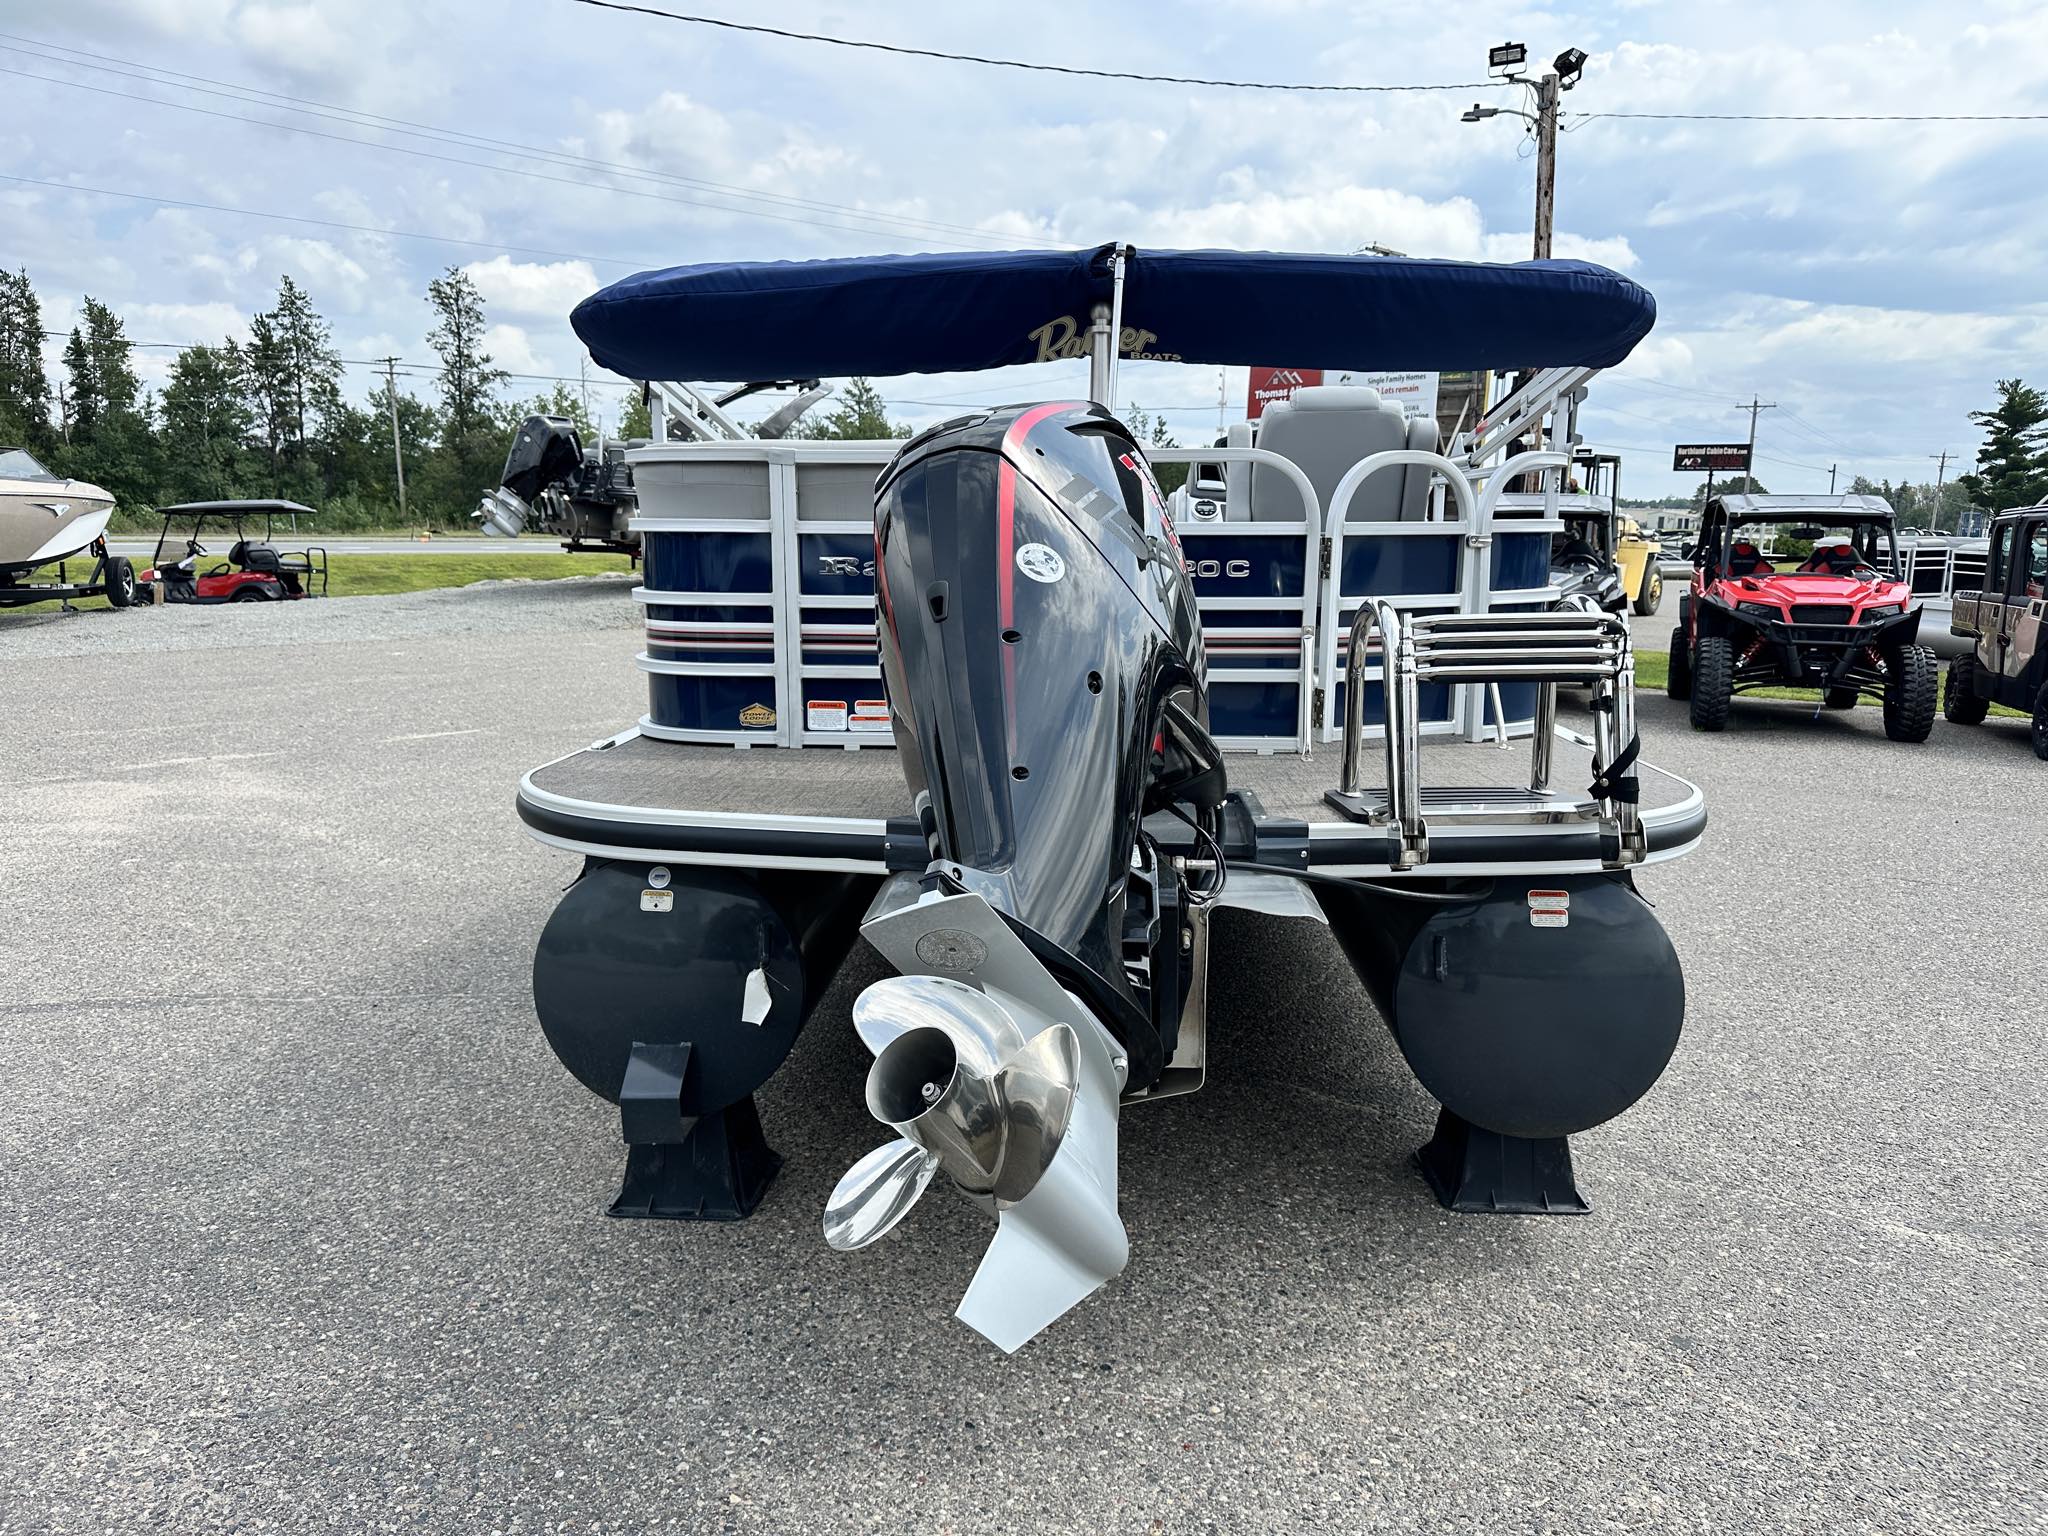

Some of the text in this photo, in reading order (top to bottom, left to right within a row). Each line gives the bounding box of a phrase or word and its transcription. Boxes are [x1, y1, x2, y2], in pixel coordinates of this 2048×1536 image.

[1130, 352, 1182, 360] BOATS
[1367, 376, 1385, 386] Single
[1386, 375, 1405, 384] Family
[1254, 389, 1288, 400] Thomas
[1381, 386, 1395, 395] Lots
[1395, 384, 1420, 393] remain
[1057, 472, 1152, 561] 115
